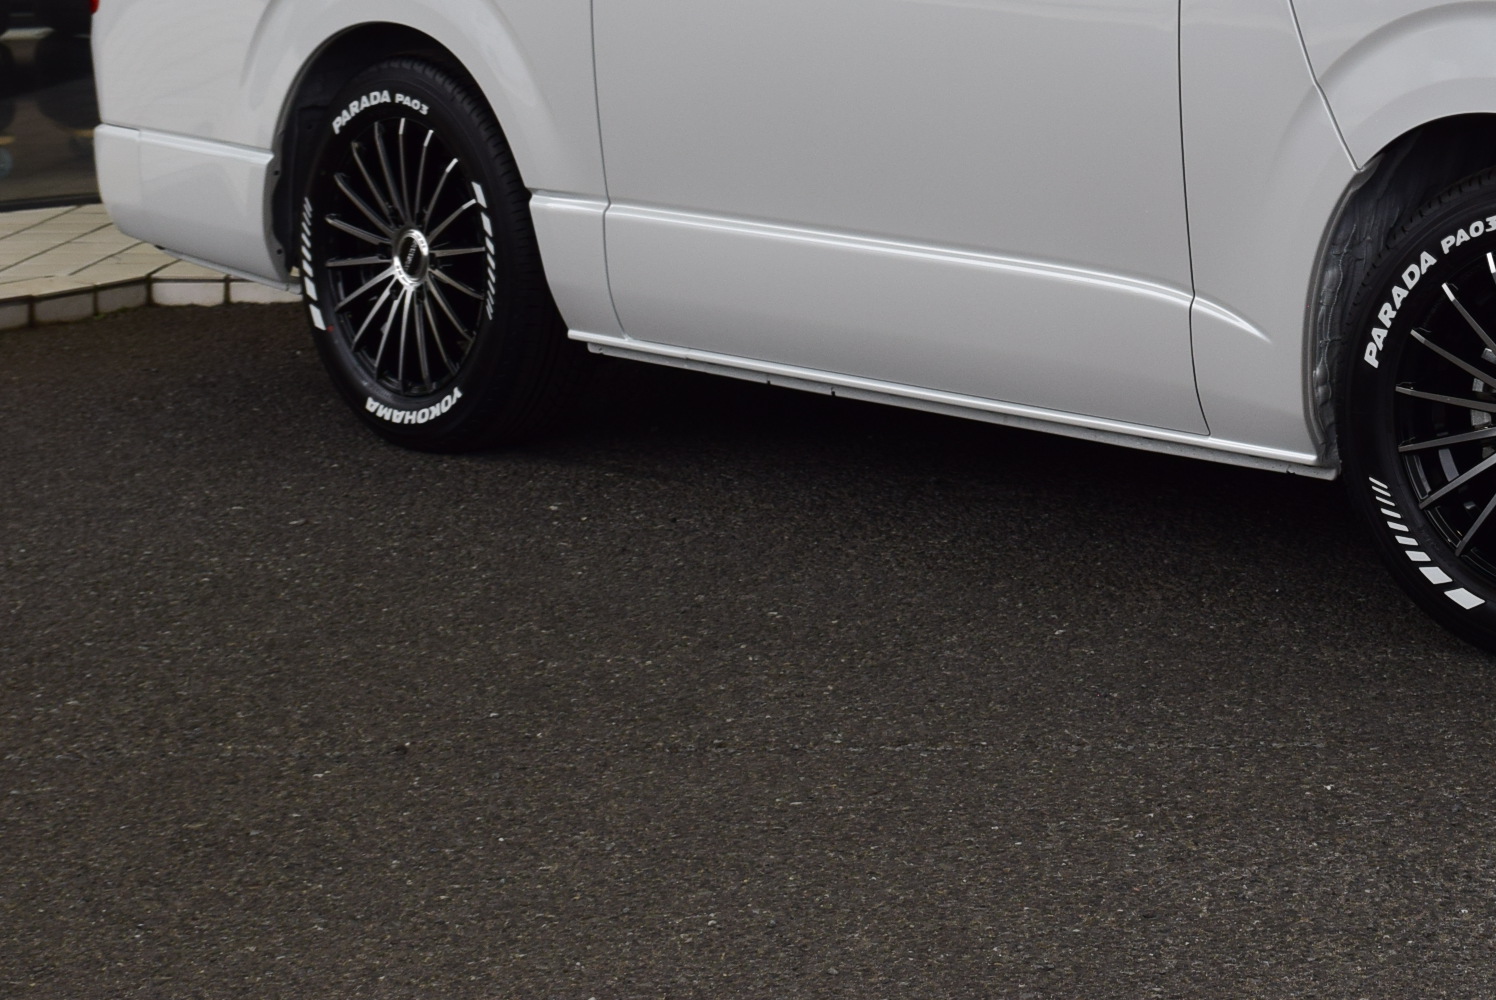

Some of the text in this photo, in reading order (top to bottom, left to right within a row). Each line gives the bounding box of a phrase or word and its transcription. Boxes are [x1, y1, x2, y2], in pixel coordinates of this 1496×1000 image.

[332, 89, 430, 135] PARADA PA03
[1364, 251, 1438, 368] PARADA
[365, 387, 463, 424] YOKOHAMA
